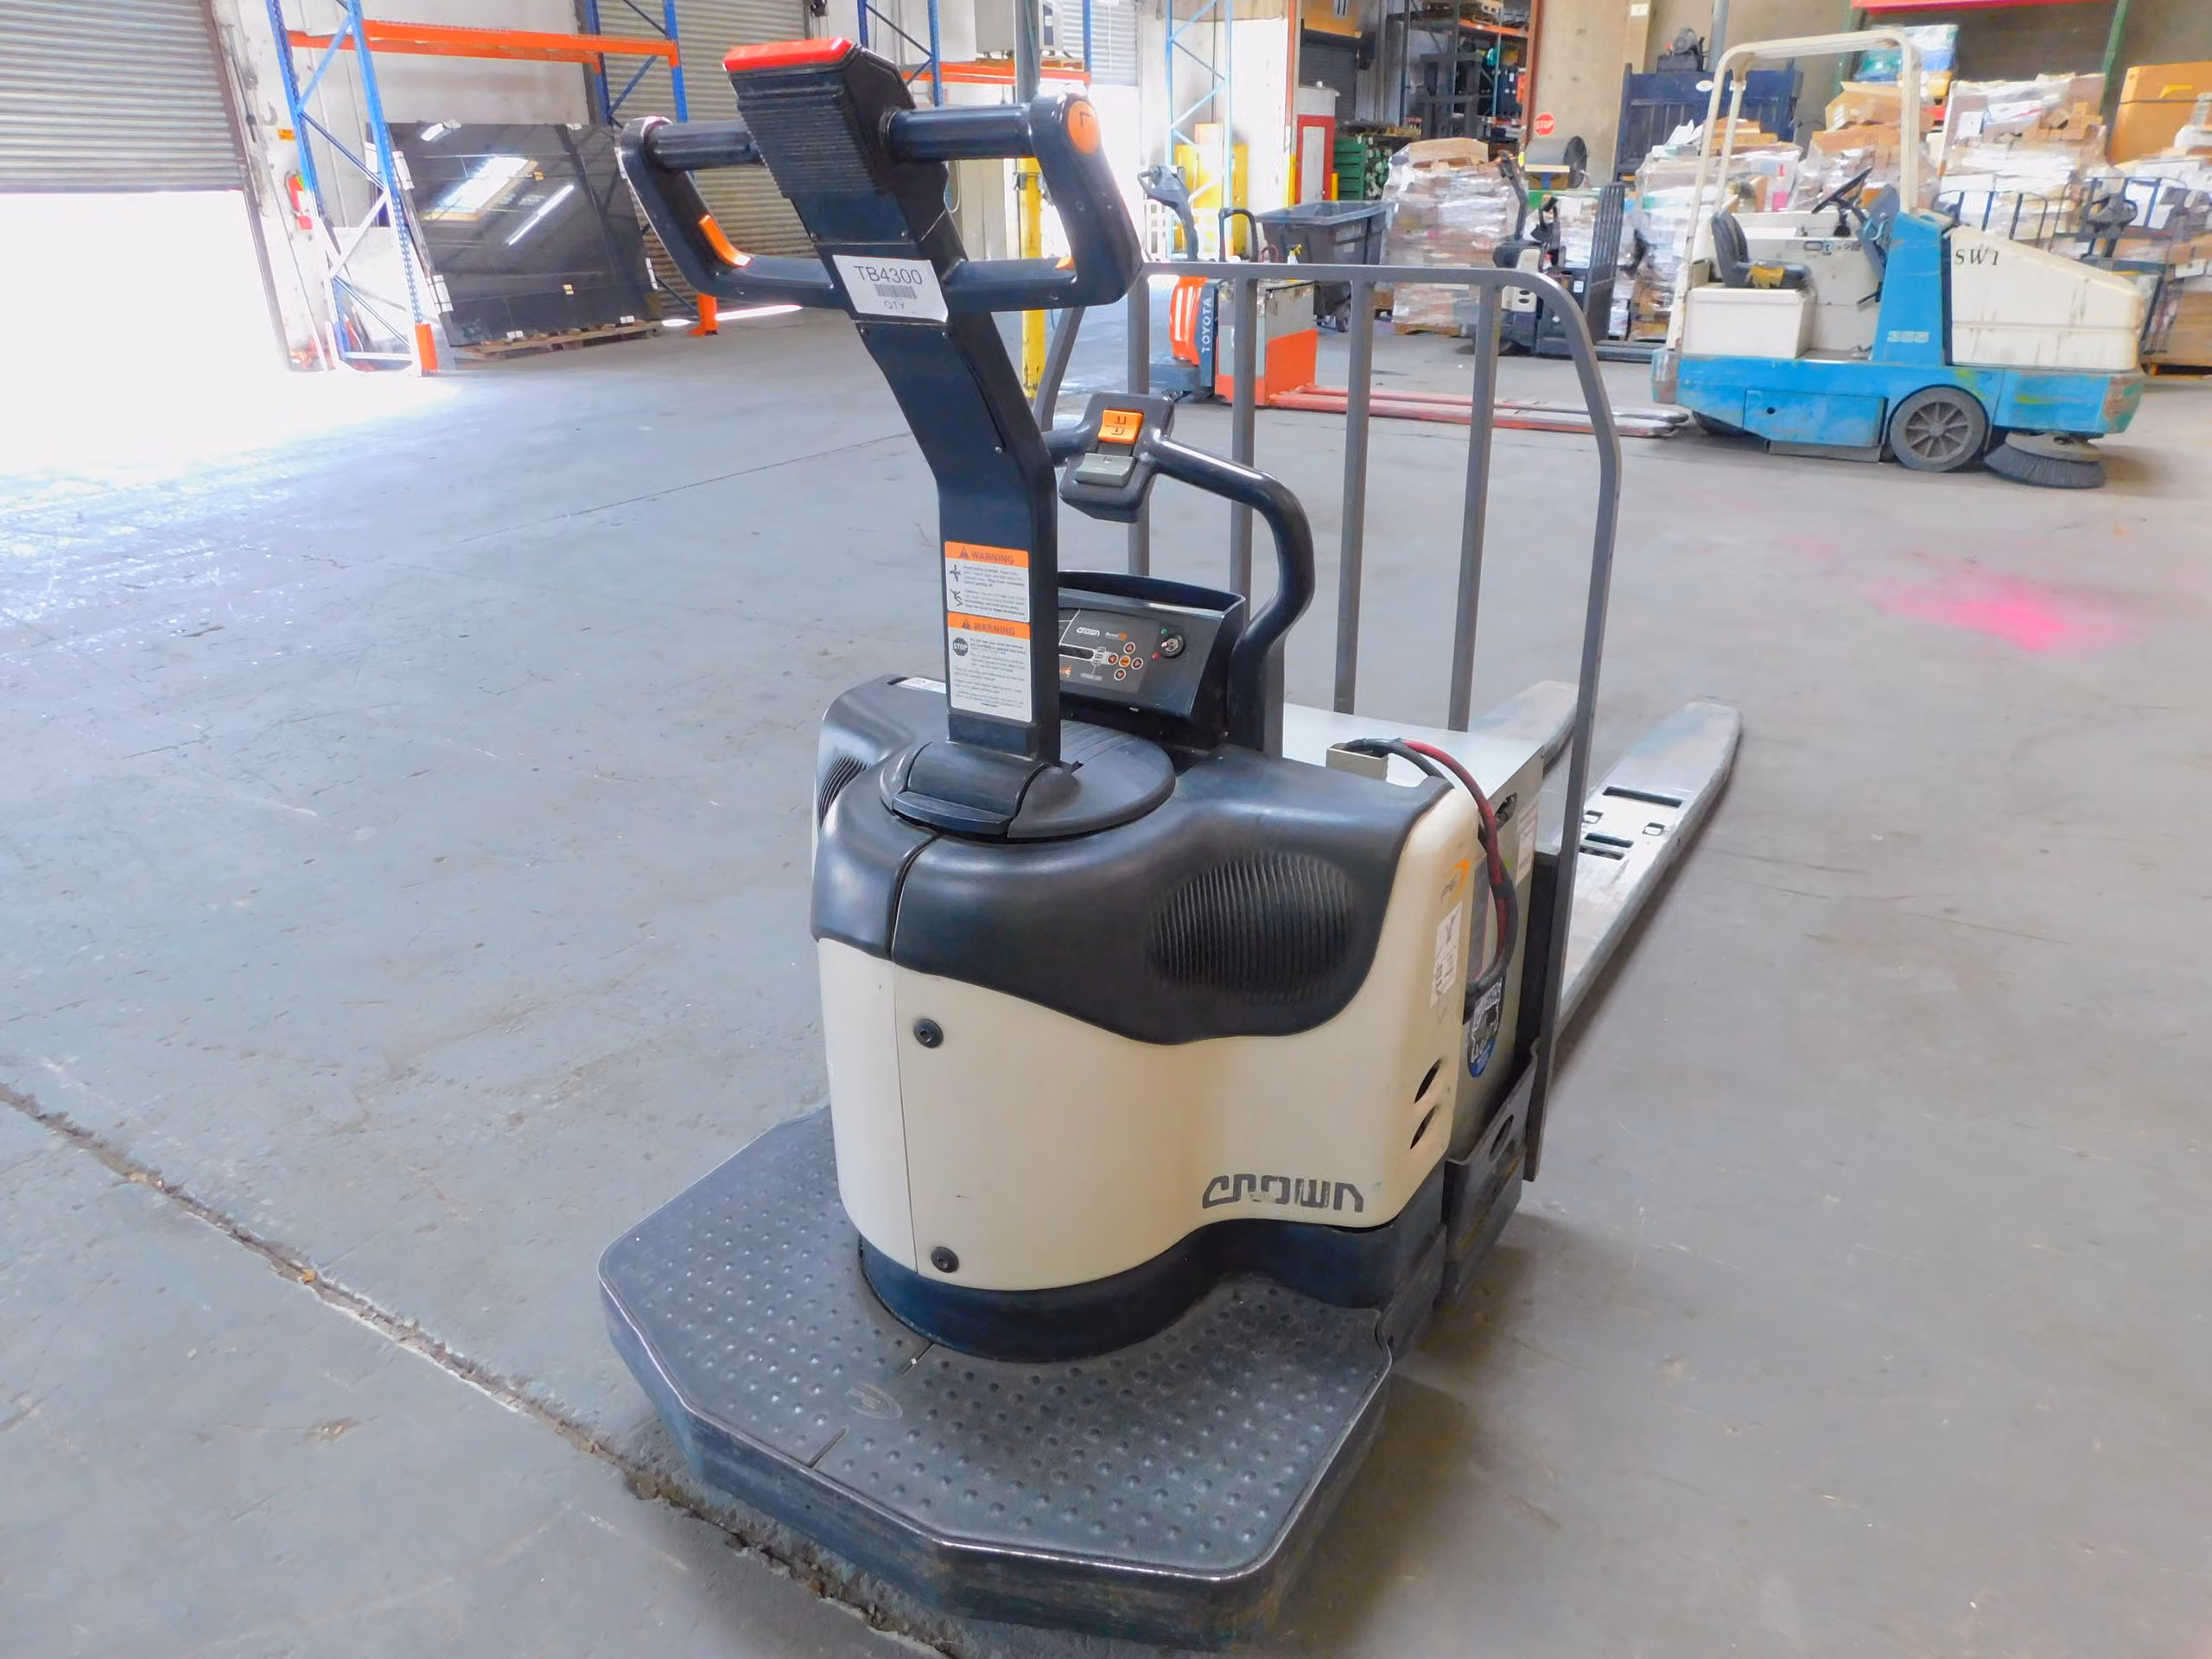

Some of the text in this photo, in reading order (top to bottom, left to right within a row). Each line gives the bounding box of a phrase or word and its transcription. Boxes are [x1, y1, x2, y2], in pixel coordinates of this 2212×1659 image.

[1535, 120, 1554, 130] STOP
[853, 264, 923, 285] TB4300
[883, 300, 906, 310] QTY
[1201, 296, 1212, 353] TOYOTA
[971, 550, 1014, 565] WARNING
[973, 621, 1016, 636] WARNING
[953, 642, 968, 651] STOP
